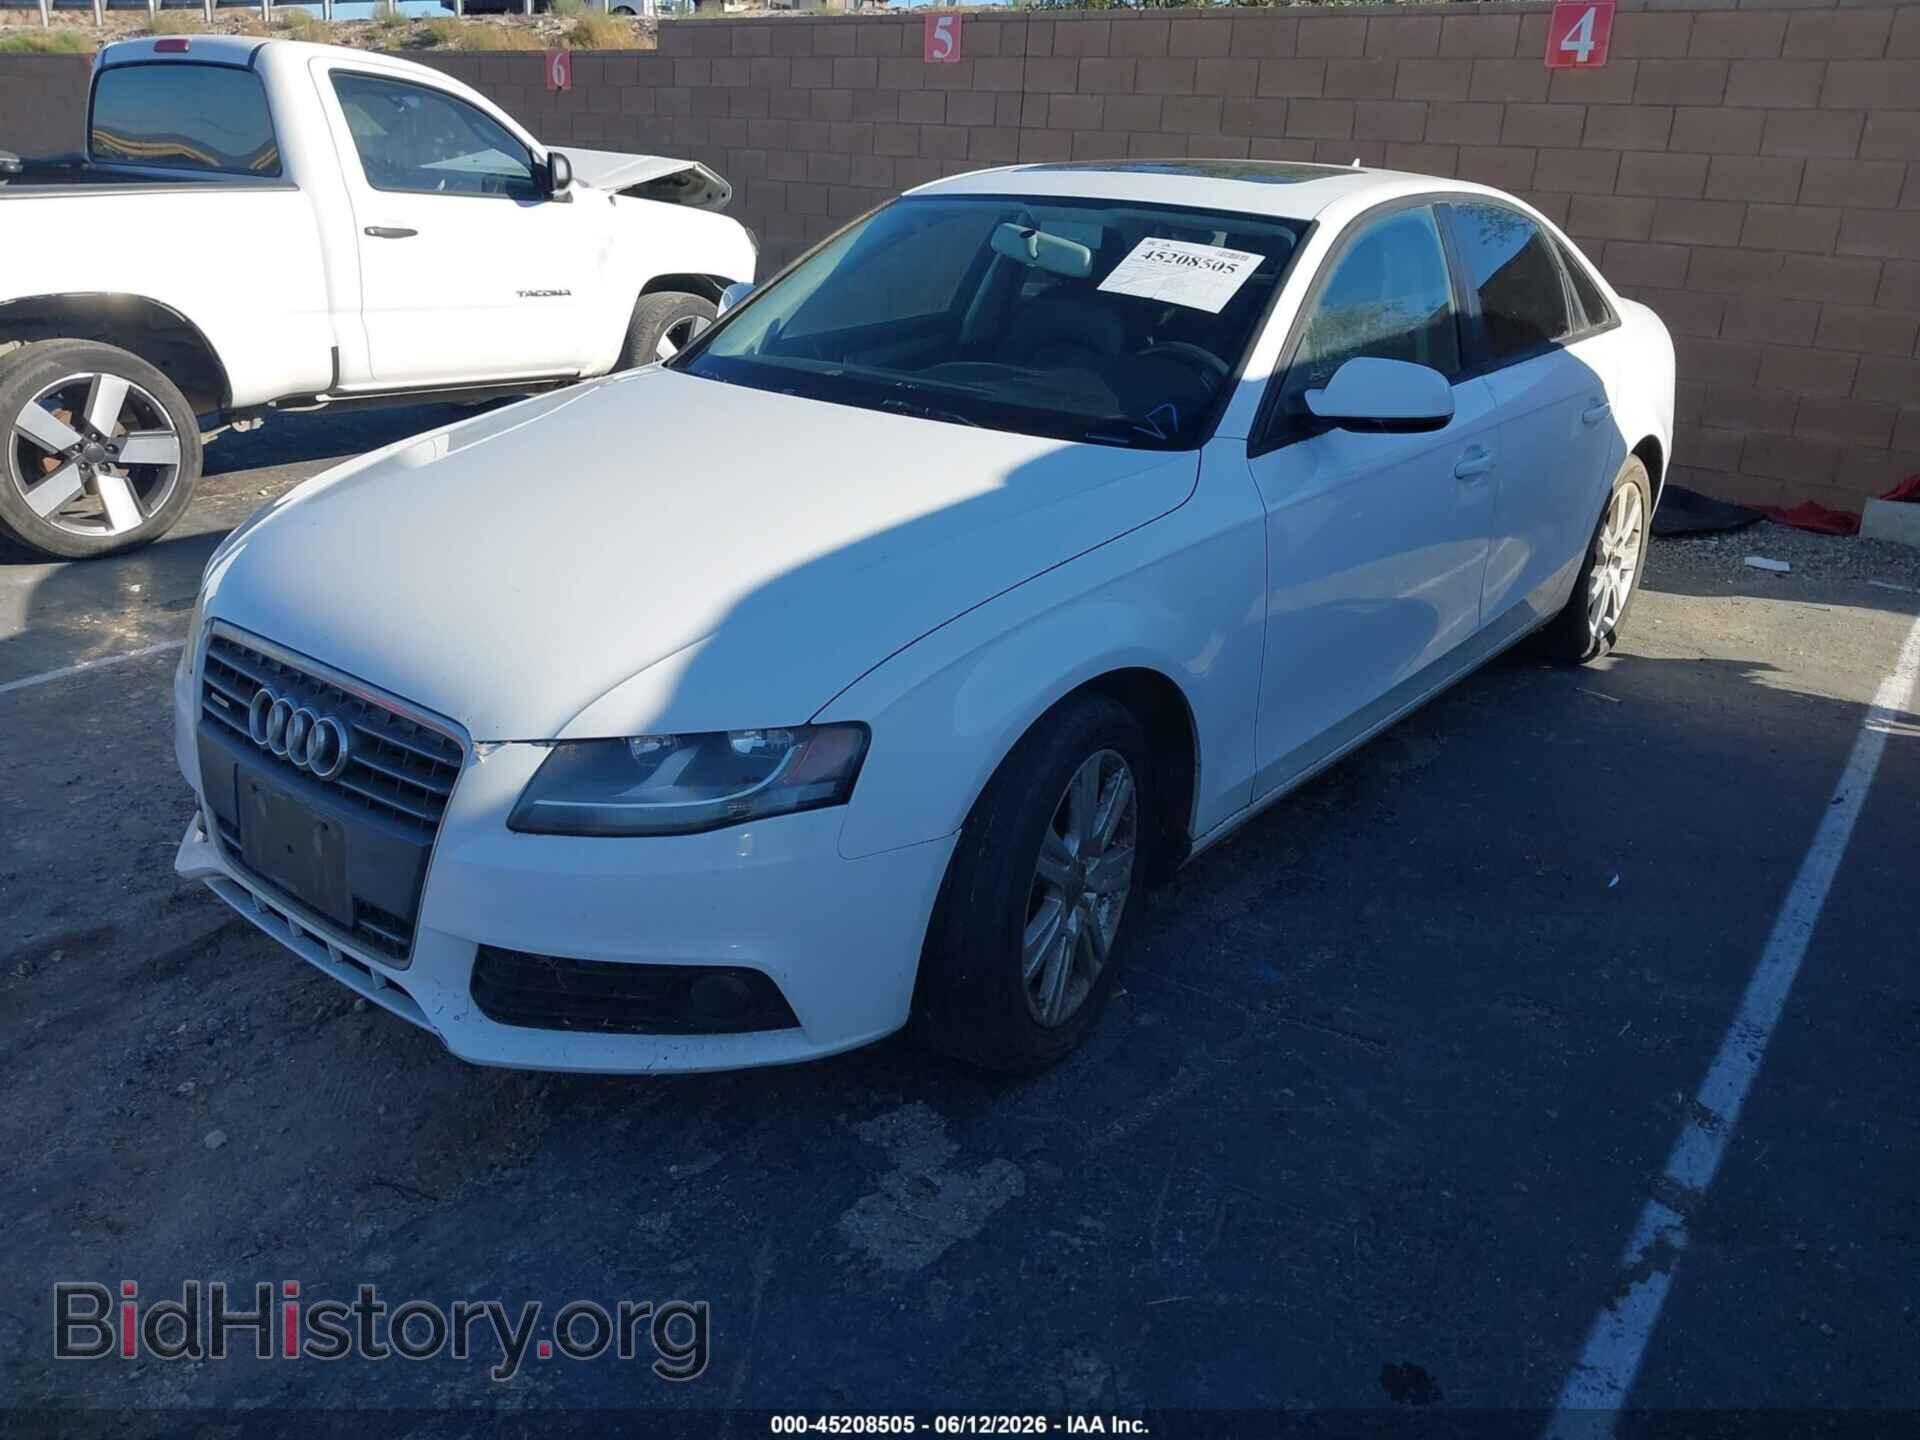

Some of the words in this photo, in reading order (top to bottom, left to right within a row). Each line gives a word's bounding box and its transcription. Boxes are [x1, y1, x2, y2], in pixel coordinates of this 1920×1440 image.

[933, 15, 953, 59] 5
[1560, 6, 1596, 62] 4
[552, 53, 565, 86] 6
[1141, 249, 1240, 275] 45208505
[516, 289, 572, 298] TACOMA
